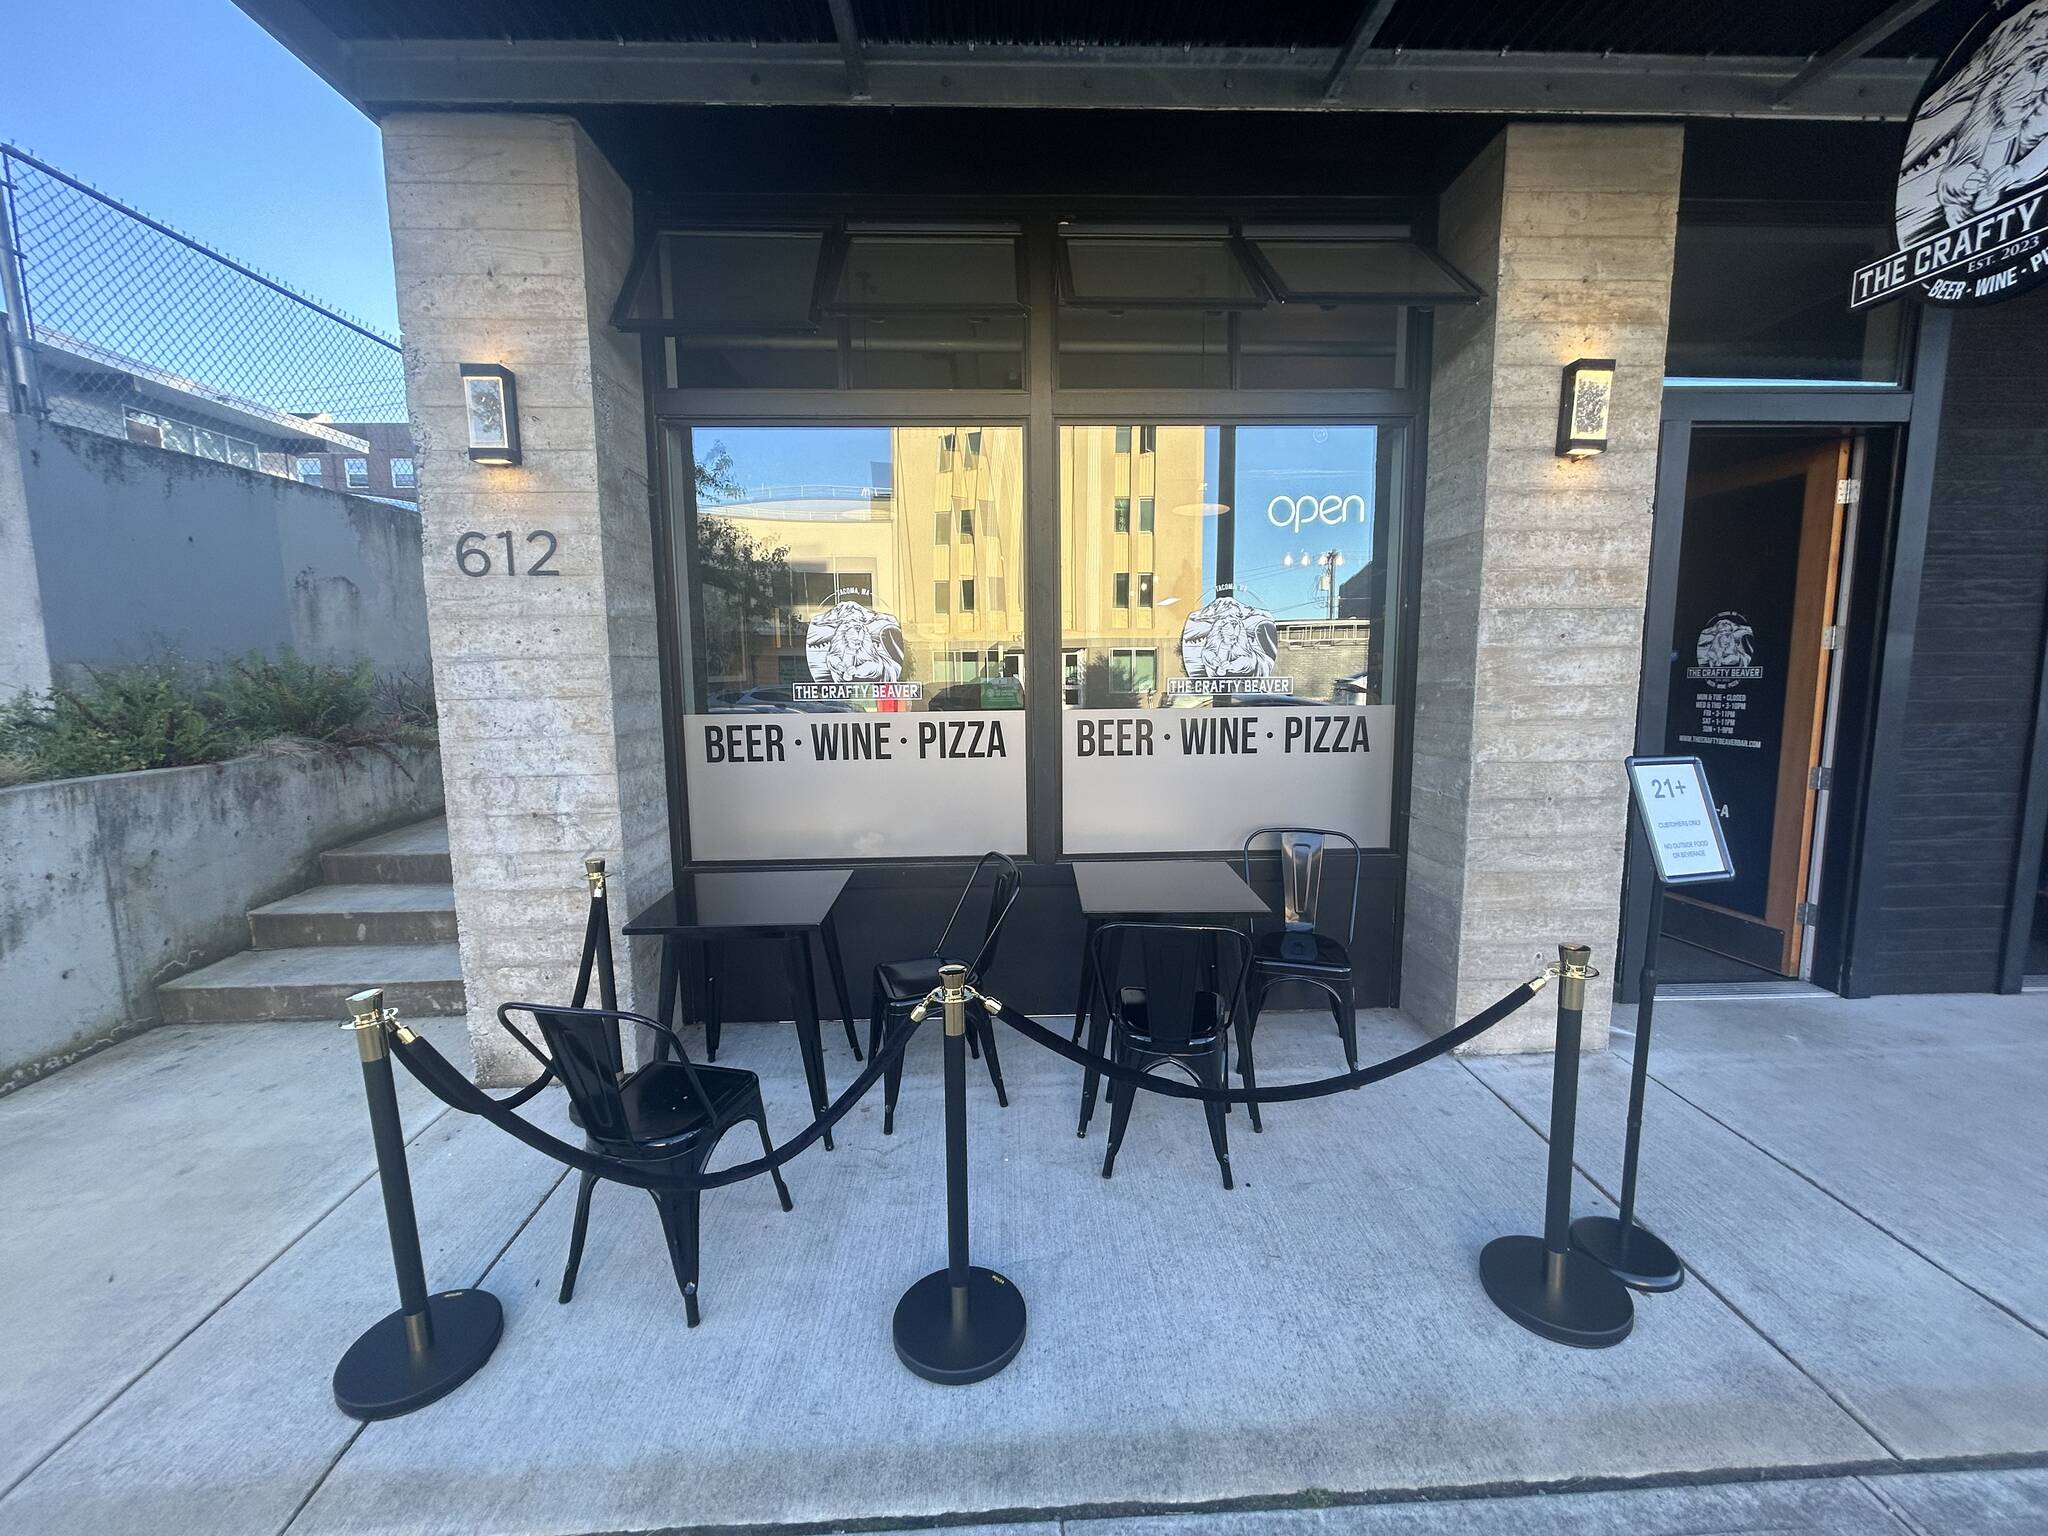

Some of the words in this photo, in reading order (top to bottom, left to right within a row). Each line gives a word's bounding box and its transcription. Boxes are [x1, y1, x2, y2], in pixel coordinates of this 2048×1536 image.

[1858, 254, 1908, 299] THE
[1914, 195, 2044, 277] CRAFTY
[1967, 258, 1996, 274] EST.
[2000, 235, 2040, 261] 2023
[1927, 278, 1967, 300] BEER
[1974, 266, 2018, 298] WINE
[1267, 494, 1365, 534] open
[456, 530, 560, 578] 612
[1689, 669, 1702, 677] THE
[1702, 669, 1730, 677] CRAFTY
[1731, 668, 1760, 677] BEAVER
[795, 686, 819, 699] THE
[821, 685, 873, 698] CRAFTY
[873, 684, 918, 698] BEAVER
[1169, 680, 1192, 693] THE
[1195, 680, 1241, 693] CRAFTY
[1244, 680, 1289, 693] BEAVER
[1726, 694, 1747, 702] CLOSED
[704, 724, 785, 763] BEER
[810, 721, 892, 761] WINE
[918, 720, 1007, 759] PIZZA
[1077, 719, 1153, 757] BEER
[1180, 717, 1258, 755] WINE
[1284, 715, 1370, 753] PIZZA
[1651, 778, 1687, 799] 21+
[1658, 821, 1688, 829] CUSTOMERS
[1689, 820, 1701, 828] ONLY
[1664, 841, 1673, 849] NO
[1673, 841, 1693, 849] OUTSIDE
[1694, 840, 1709, 848] FOOD
[1681, 850, 1706, 858] BEVERAGE
